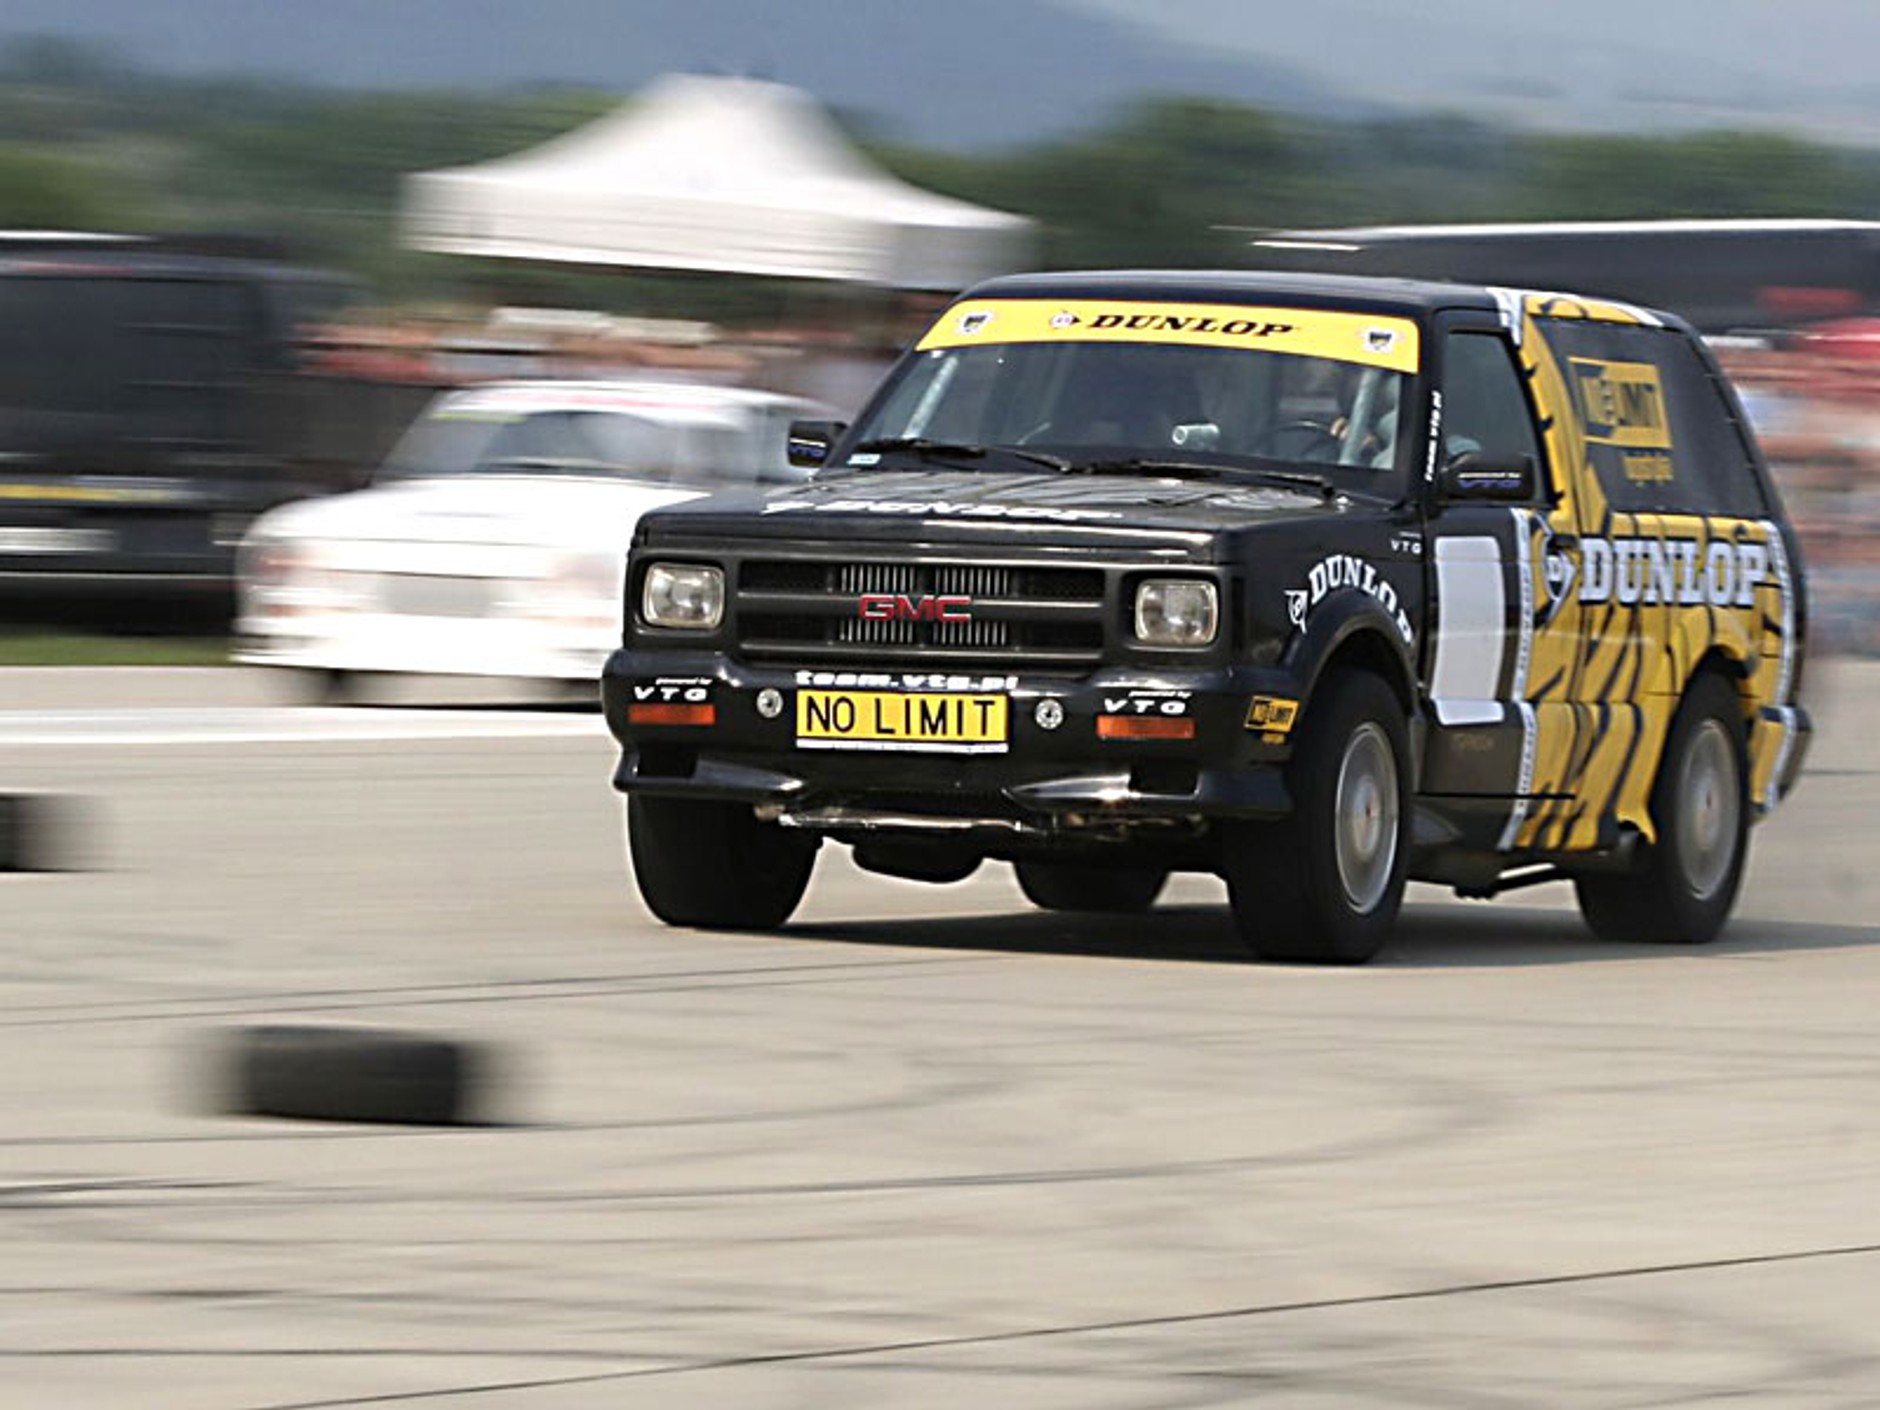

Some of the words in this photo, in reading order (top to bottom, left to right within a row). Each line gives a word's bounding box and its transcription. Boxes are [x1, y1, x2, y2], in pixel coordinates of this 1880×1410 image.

[1088, 313, 1293, 338] DUNLOP
[1390, 538, 1422, 555] VTG
[1578, 538, 1767, 606] DUNLOP
[859, 594, 972, 622] GMC
[1308, 554, 1414, 644] DUNLOP
[633, 686, 708, 702] VTG
[1103, 699, 1187, 715] VTG
[805, 695, 857, 733] NO
[873, 696, 997, 737] LIMIT
